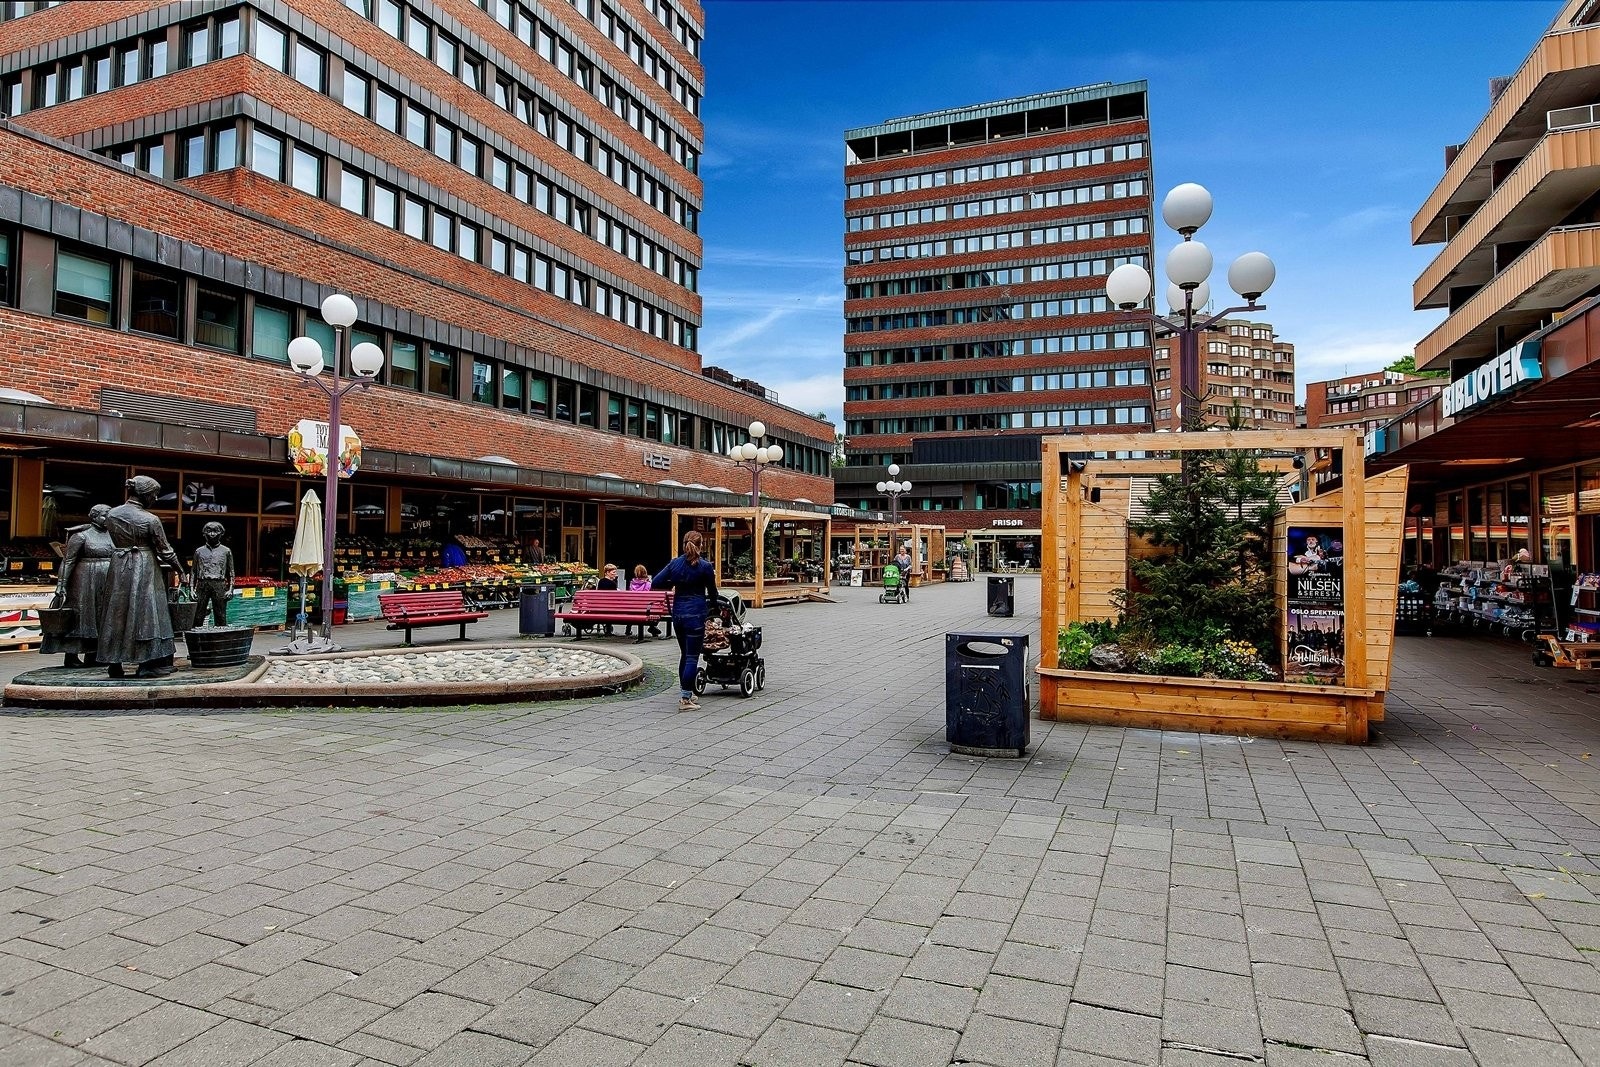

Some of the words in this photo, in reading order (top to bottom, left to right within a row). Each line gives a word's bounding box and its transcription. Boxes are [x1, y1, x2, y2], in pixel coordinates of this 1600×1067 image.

[1442, 341, 1525, 418] BIBLIOTEK
[315, 424, 329, 435] TØY
[1297, 580, 1341, 591] NILSEN
